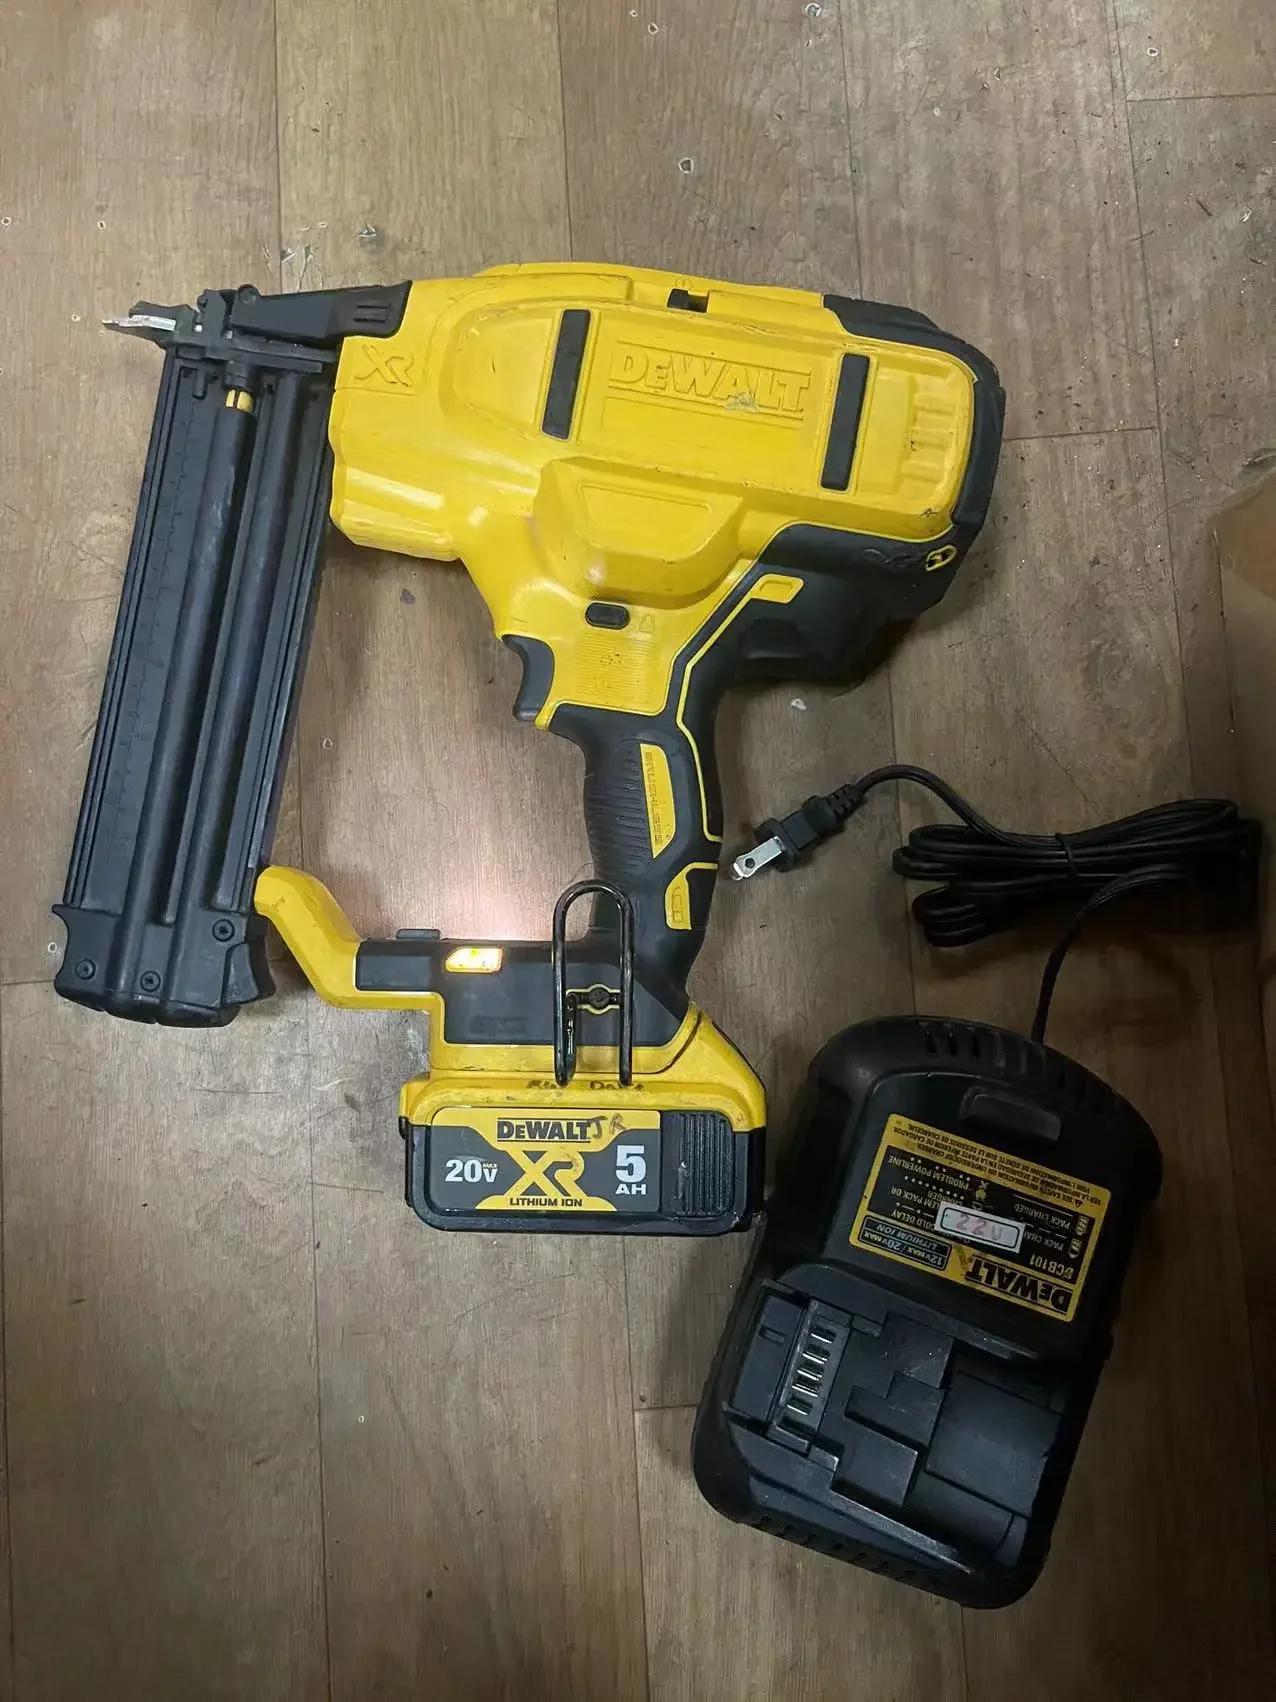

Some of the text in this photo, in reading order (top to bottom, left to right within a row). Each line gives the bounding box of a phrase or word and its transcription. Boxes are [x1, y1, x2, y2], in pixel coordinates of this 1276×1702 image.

[353, 343, 415, 388] XR
[504, 1149, 588, 1199] XR
[615, 1145, 647, 1184] 5
[886, 1153, 970, 1190] PROBLEM POWERLINE
[509, 1197, 583, 1207] LITHIUM ION
[615, 1184, 647, 1195] AH
[889, 1185, 903, 1196] OR
[900, 1189, 923, 1203] PACK
[889, 1208, 915, 1223] DELAY
[1012, 1201, 1071, 1230] PACK CHARGED
[875, 1222, 937, 1250] LITHIUM ION
[1041, 1236, 1064, 1251] PACK
[1027, 1252, 1075, 1280] DCB101
